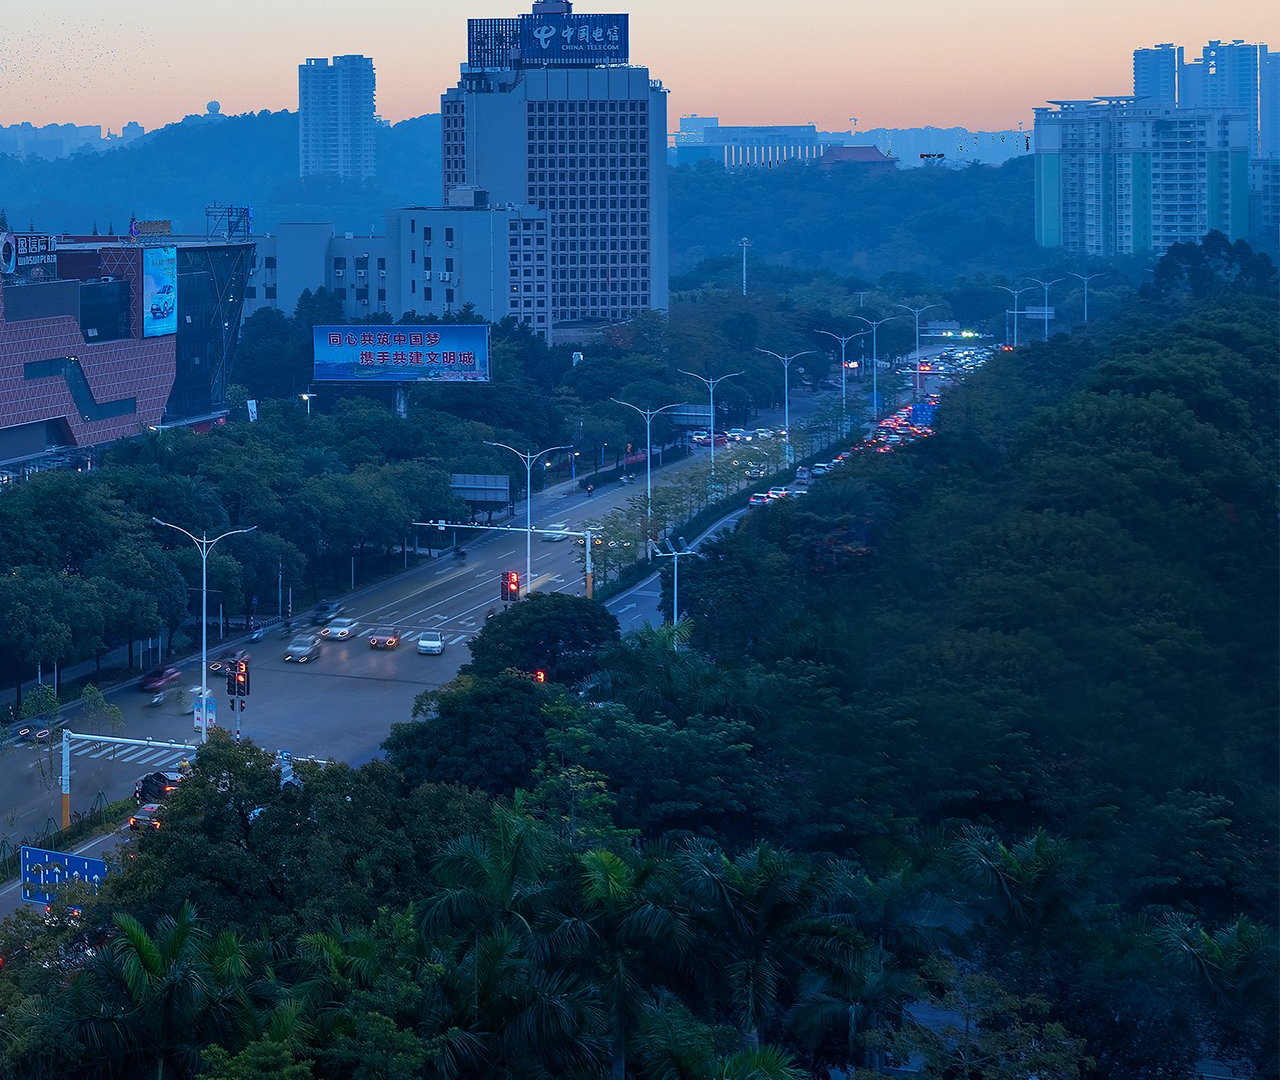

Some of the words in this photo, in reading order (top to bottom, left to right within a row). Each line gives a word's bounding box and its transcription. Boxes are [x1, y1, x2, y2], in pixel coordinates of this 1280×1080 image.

[561, 24, 619, 43] 中国电信
[18, 235, 57, 255] 盈信广场
[328, 332, 440, 346] 同心共筑中国梦
[359, 351, 474, 365] 携手共建文明城
